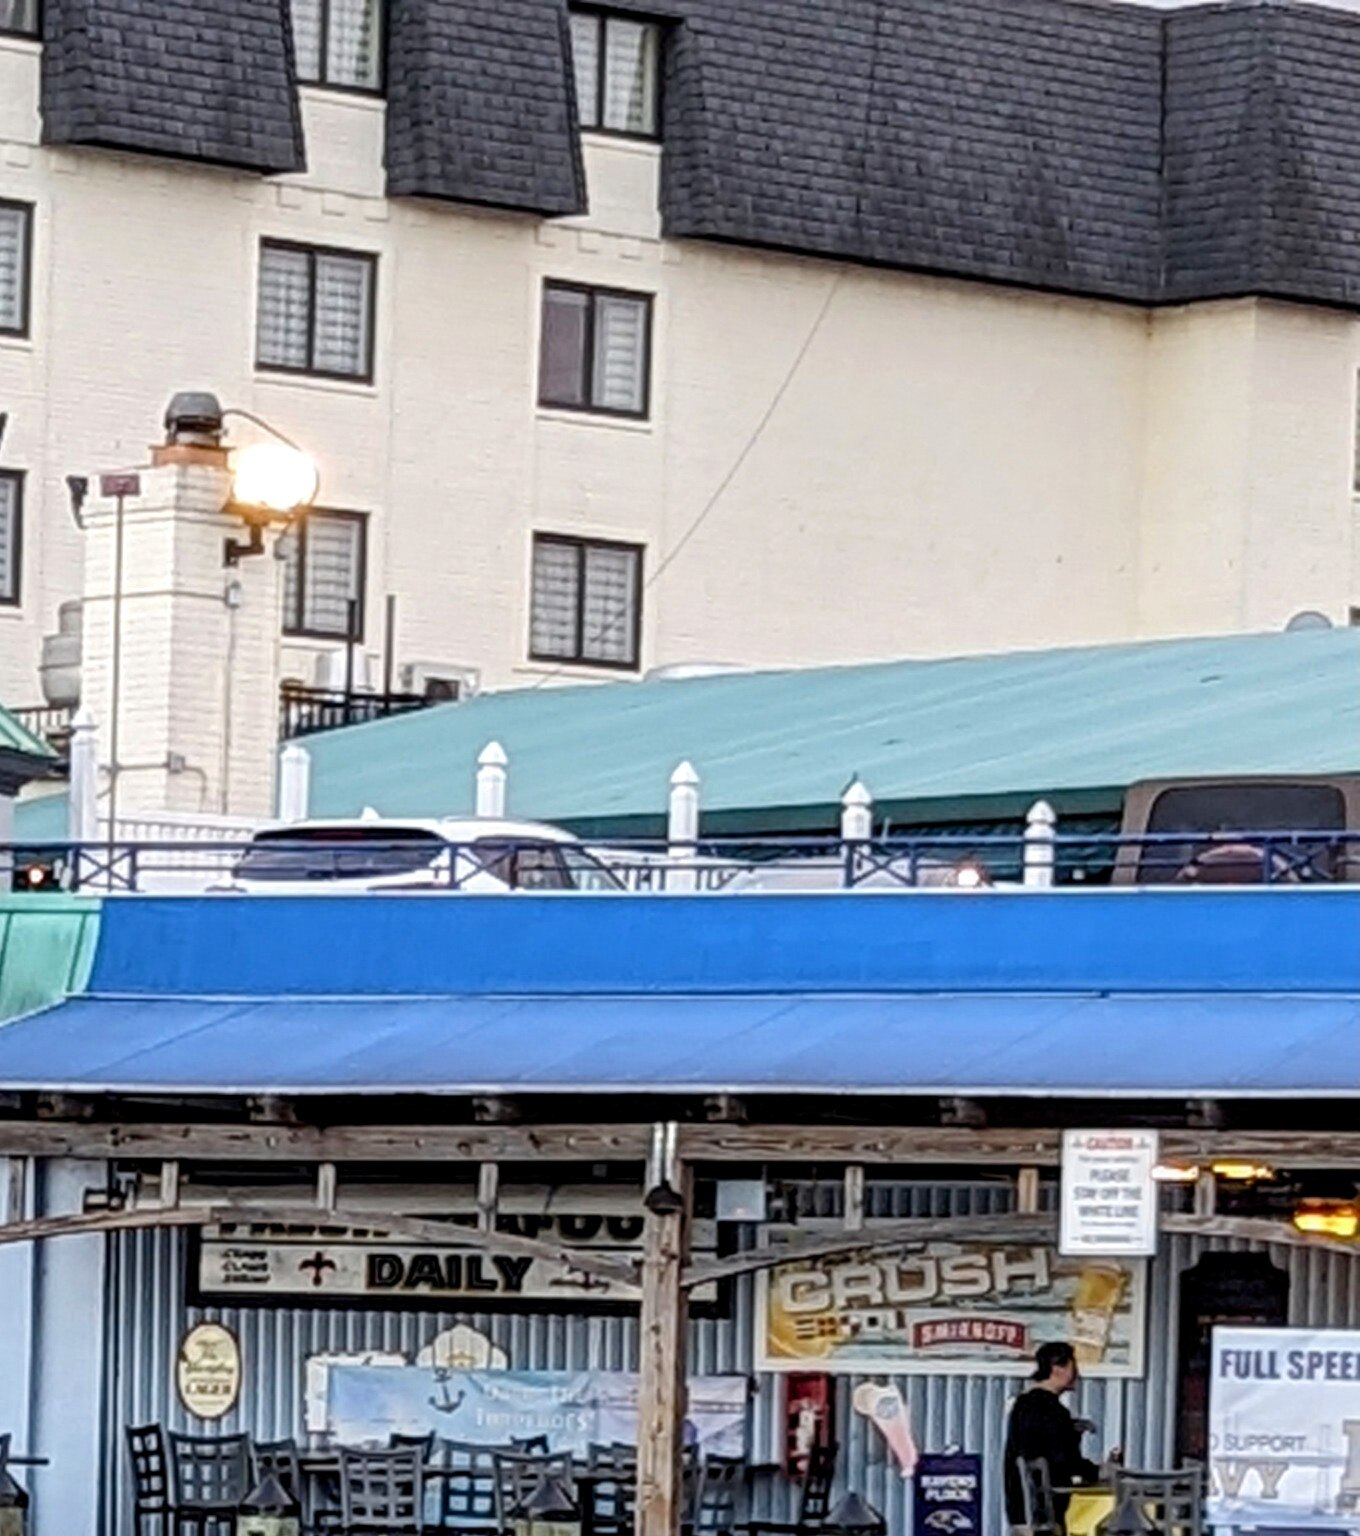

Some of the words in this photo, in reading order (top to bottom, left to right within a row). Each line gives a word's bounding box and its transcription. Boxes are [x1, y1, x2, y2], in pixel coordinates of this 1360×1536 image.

[1089, 1169, 1131, 1182] PLEASE
[366, 1253, 534, 1292] DAILY
[779, 1246, 1051, 1315] CRUSH
[920, 1321, 1018, 1347] SMIRNOFF
[1219, 1350, 1281, 1380] FULL
[1287, 1350, 1360, 1381] SPEE
[1223, 1435, 1307, 1452] SUPPORT
